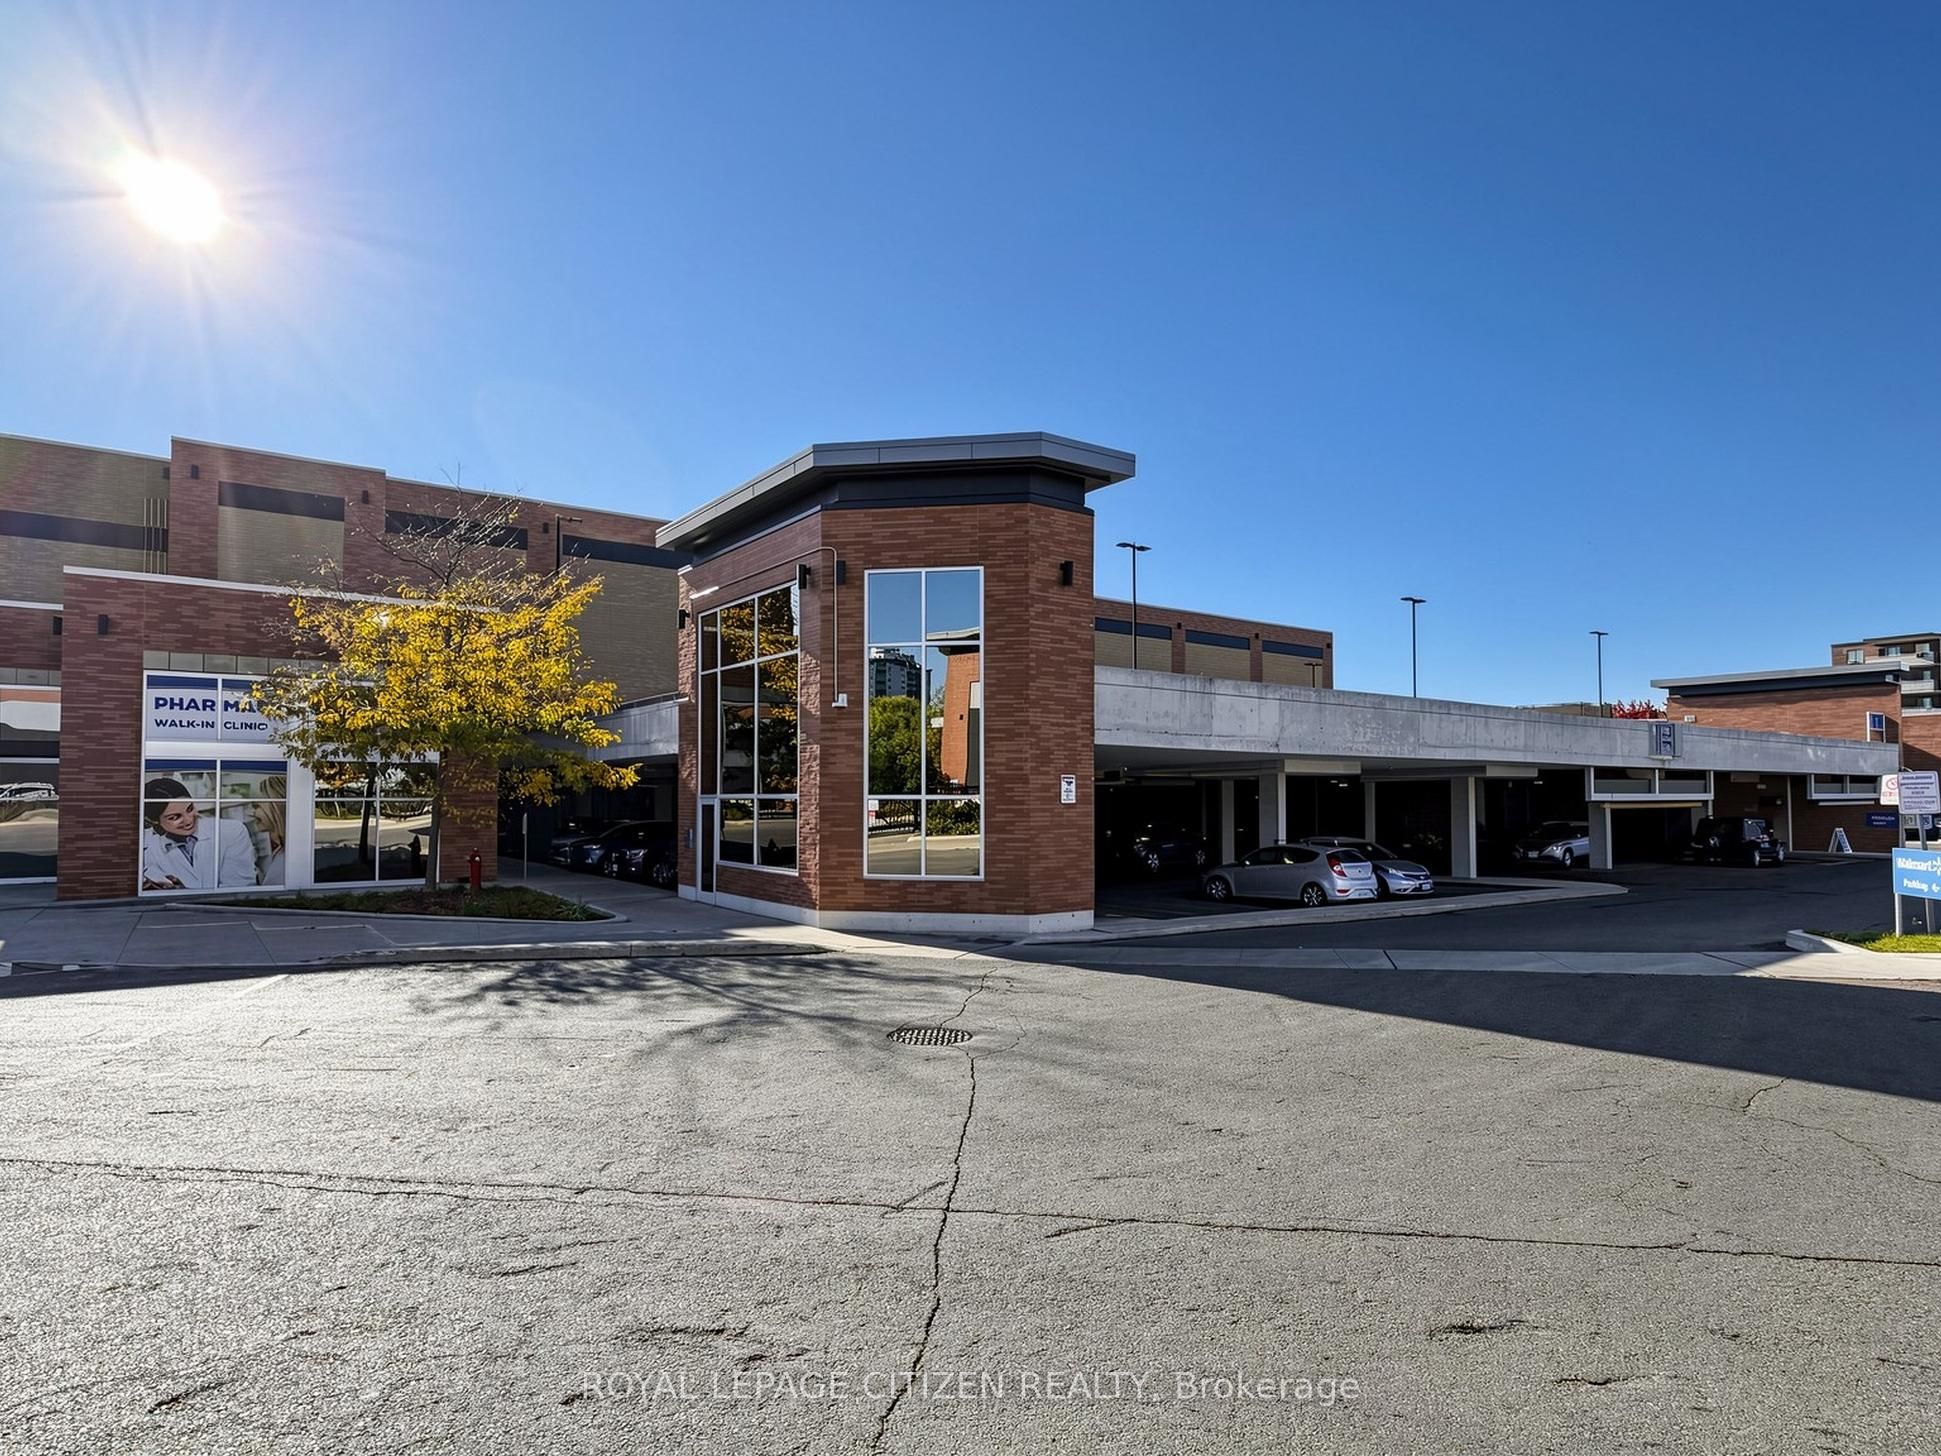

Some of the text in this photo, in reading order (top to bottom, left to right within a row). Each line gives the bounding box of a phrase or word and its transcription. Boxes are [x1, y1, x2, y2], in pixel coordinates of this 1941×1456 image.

[154, 696, 268, 713] PHARMA
[154, 718, 216, 729] WALK-IN
[1895, 857, 1936, 872] Walmart
